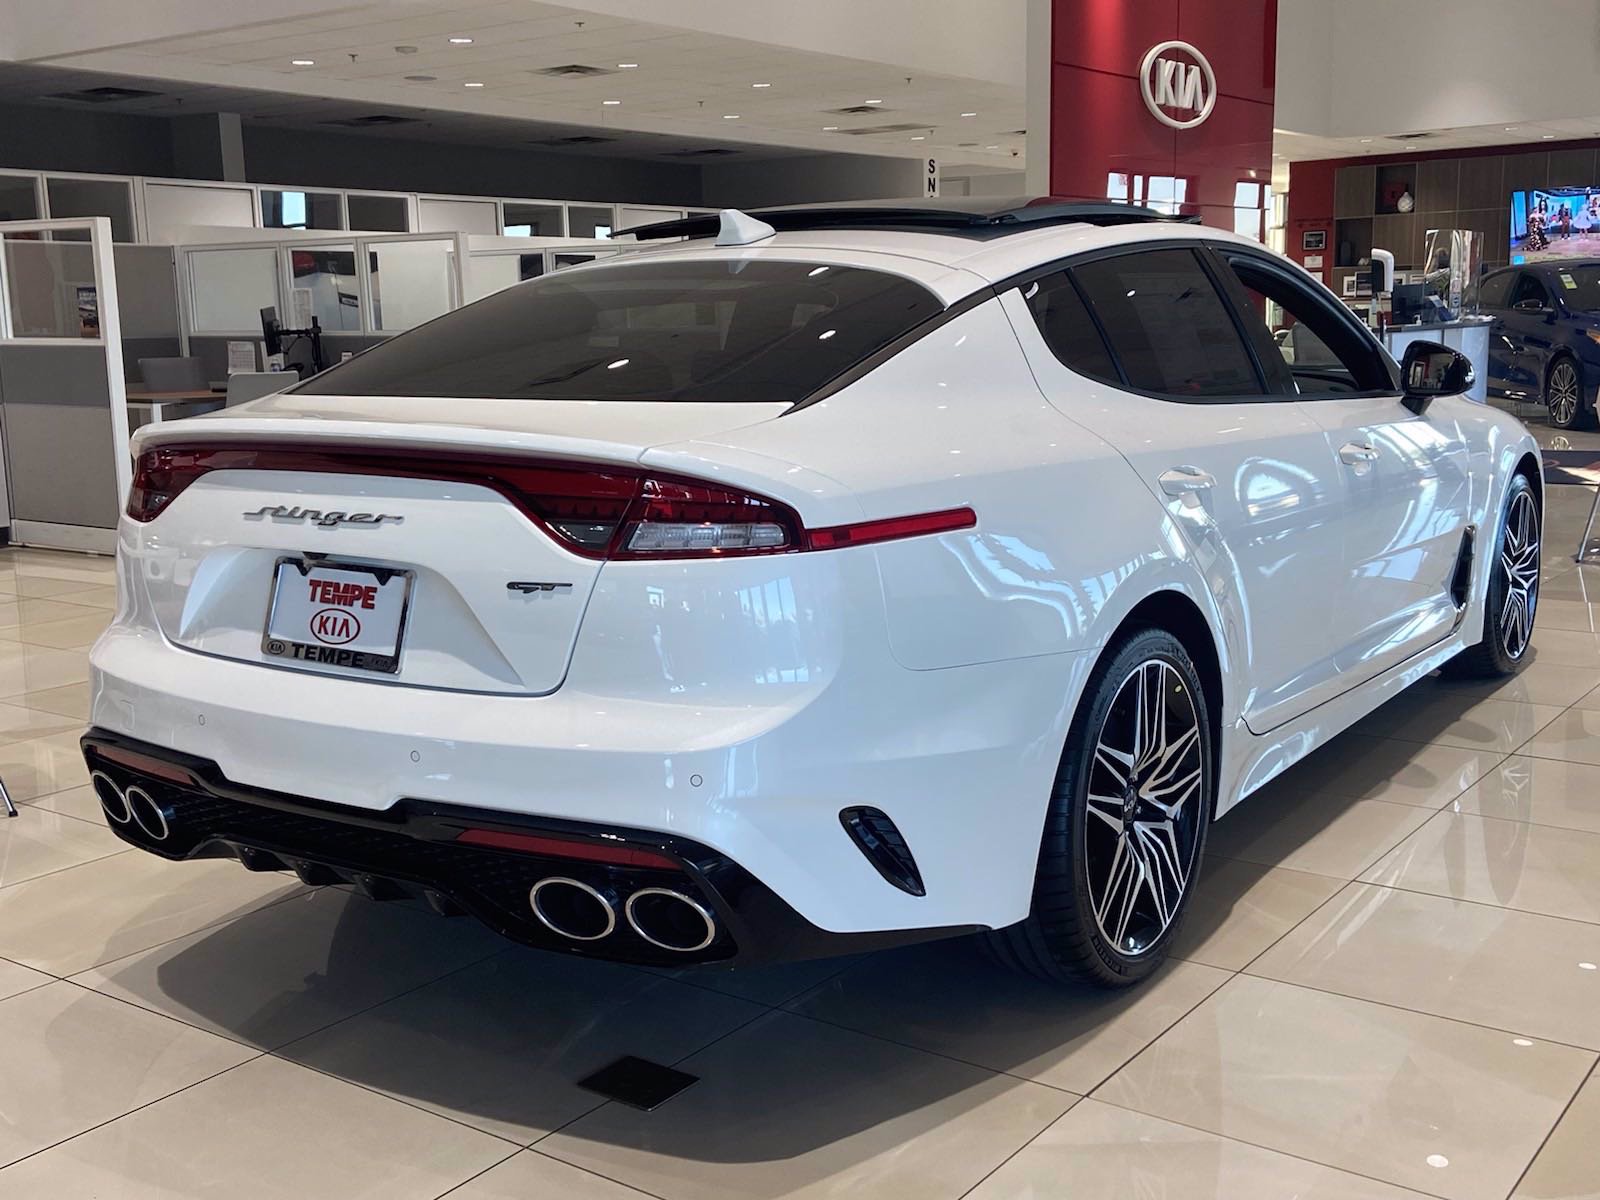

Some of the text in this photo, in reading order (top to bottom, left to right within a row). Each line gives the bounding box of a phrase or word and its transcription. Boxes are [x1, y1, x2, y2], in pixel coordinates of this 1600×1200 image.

[1154, 57, 1204, 112] KIA
[309, 579, 378, 610] TEMPE
[506, 581, 573, 594] GT
[317, 615, 350, 639] KIA
[291, 643, 364, 667] TEMPE
